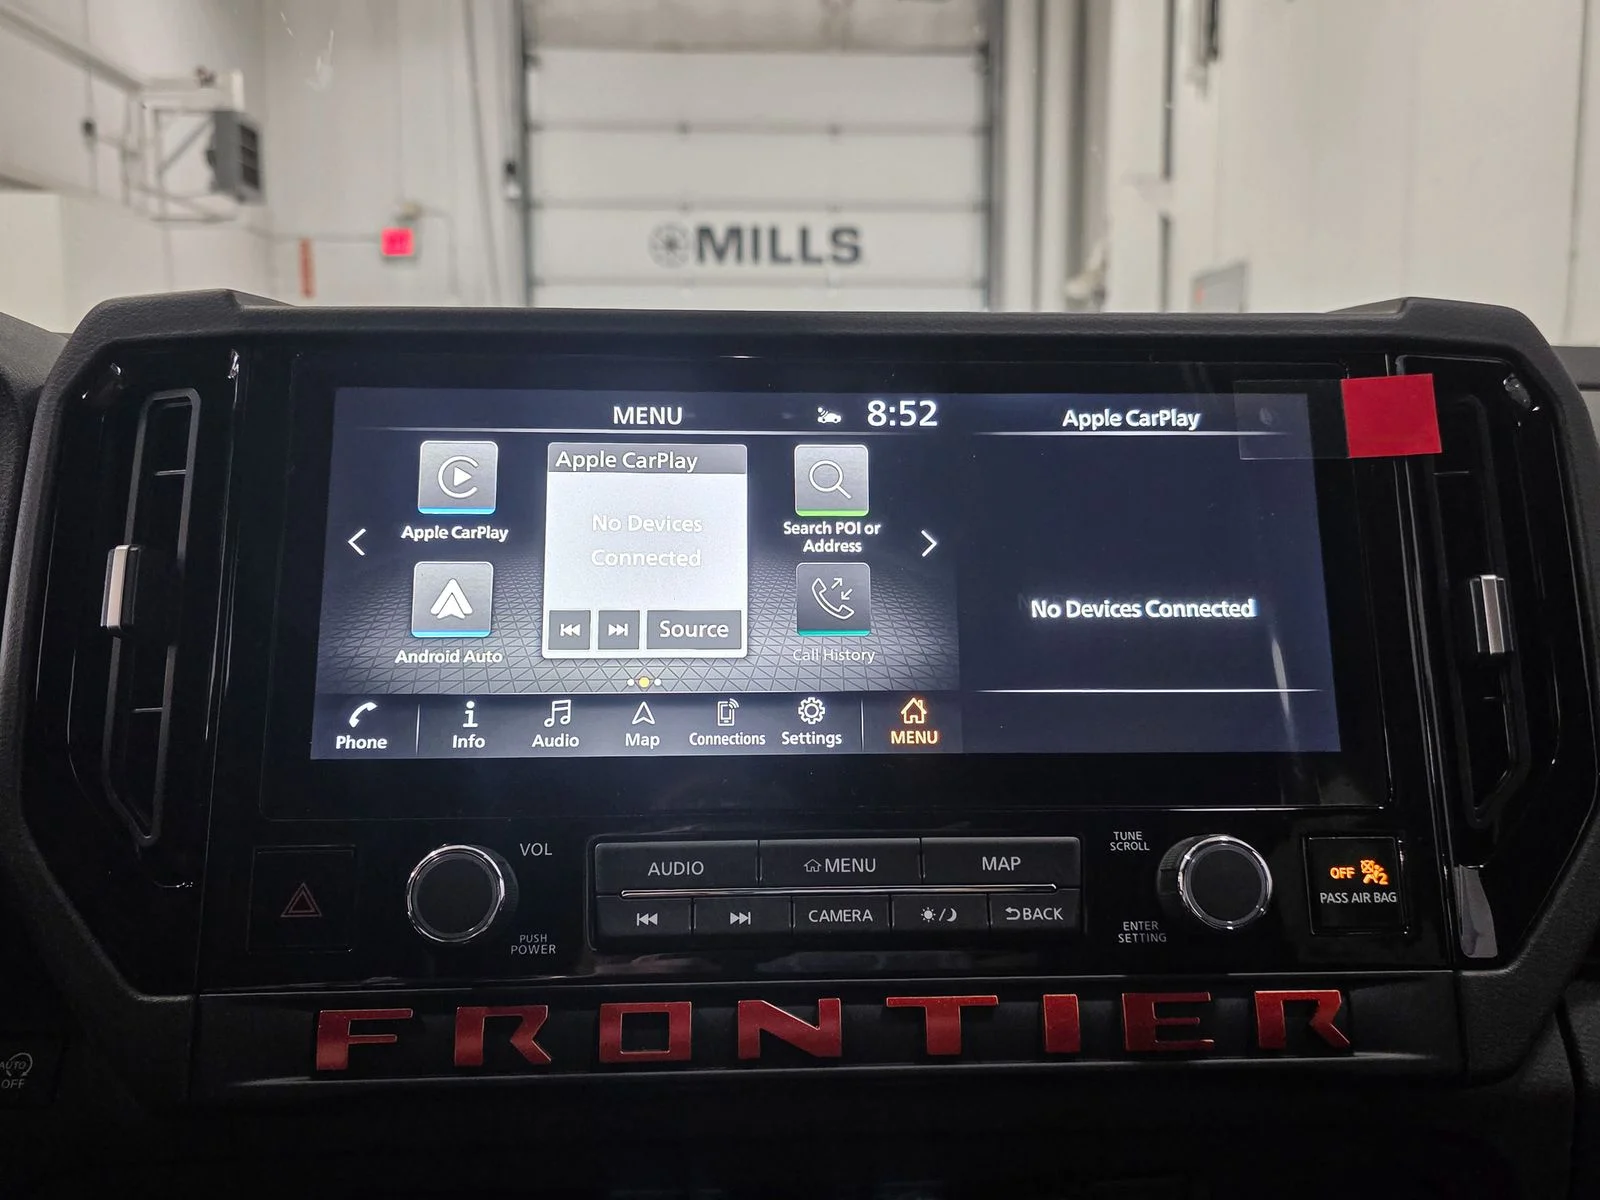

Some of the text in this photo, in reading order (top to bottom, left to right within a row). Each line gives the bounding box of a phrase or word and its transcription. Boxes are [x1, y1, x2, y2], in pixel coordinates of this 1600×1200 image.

[696, 224, 863, 265] MILLS
[613, 406, 683, 425] MENU
[866, 399, 938, 427] 8:52
[1062, 409, 1201, 430] Apple CarPlay
[555, 451, 699, 473] Apple CarPlay
[592, 514, 703, 533] No Devices
[783, 521, 881, 535] Search POI or
[401, 525, 509, 542] Apple CarPlay
[803, 539, 862, 553] Address
[591, 549, 701, 567] Connected
[1031, 599, 1257, 618] No Devices Connected
[659, 620, 730, 638] Source
[395, 650, 503, 664] Android Auto
[793, 649, 876, 665] Call History
[335, 735, 388, 750] Phone
[452, 735, 486, 748] Info
[532, 734, 580, 748] Audio
[625, 733, 660, 749] Map
[689, 732, 766, 746] Connections
[781, 732, 842, 748] Settings
[890, 731, 938, 745] MENU
[1113, 831, 1143, 841] TUNE
[519, 843, 553, 857] VOL
[1110, 841, 1151, 851] SCROLL
[647, 861, 705, 877] AUDIO
[824, 858, 877, 873] MENU
[981, 856, 1021, 871] MAP
[1329, 866, 1356, 879] OFF
[1319, 892, 1397, 903] PASS AIR BAG
[808, 909, 874, 923] CAMERA
[1022, 907, 1064, 921] BACK
[1123, 921, 1159, 931] ENTER
[519, 934, 548, 943] PUSH
[1118, 933, 1167, 944] SETTING
[510, 944, 556, 955] POWER
[315, 989, 1352, 1071] FRONTIER
[1, 1079, 25, 1089] OFF
